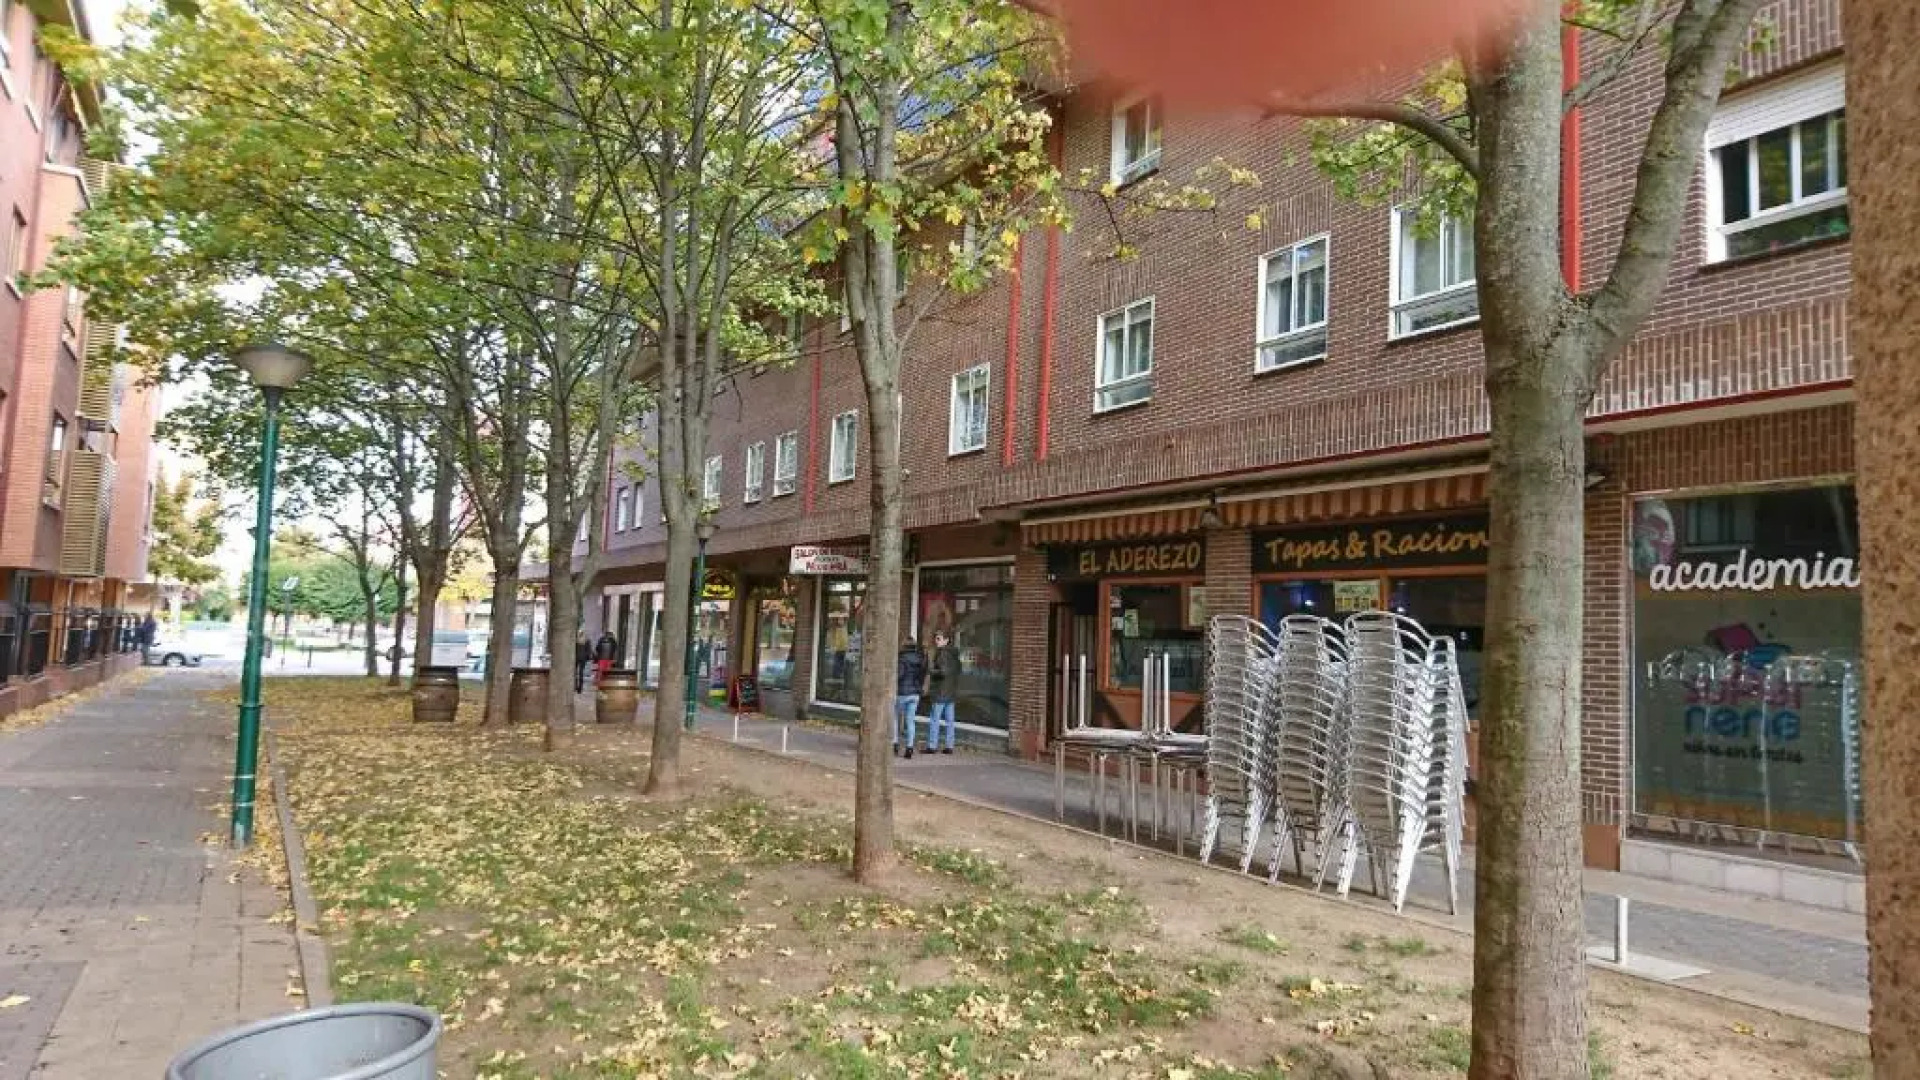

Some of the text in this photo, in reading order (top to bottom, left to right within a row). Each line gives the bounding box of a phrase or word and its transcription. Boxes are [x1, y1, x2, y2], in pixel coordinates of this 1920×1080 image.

[1080, 541, 1200, 575] EL ADEREZO
[1265, 537, 1339, 567] Tapas
[1342, 531, 1366, 559] &
[1650, 549, 1860, 591] academia
